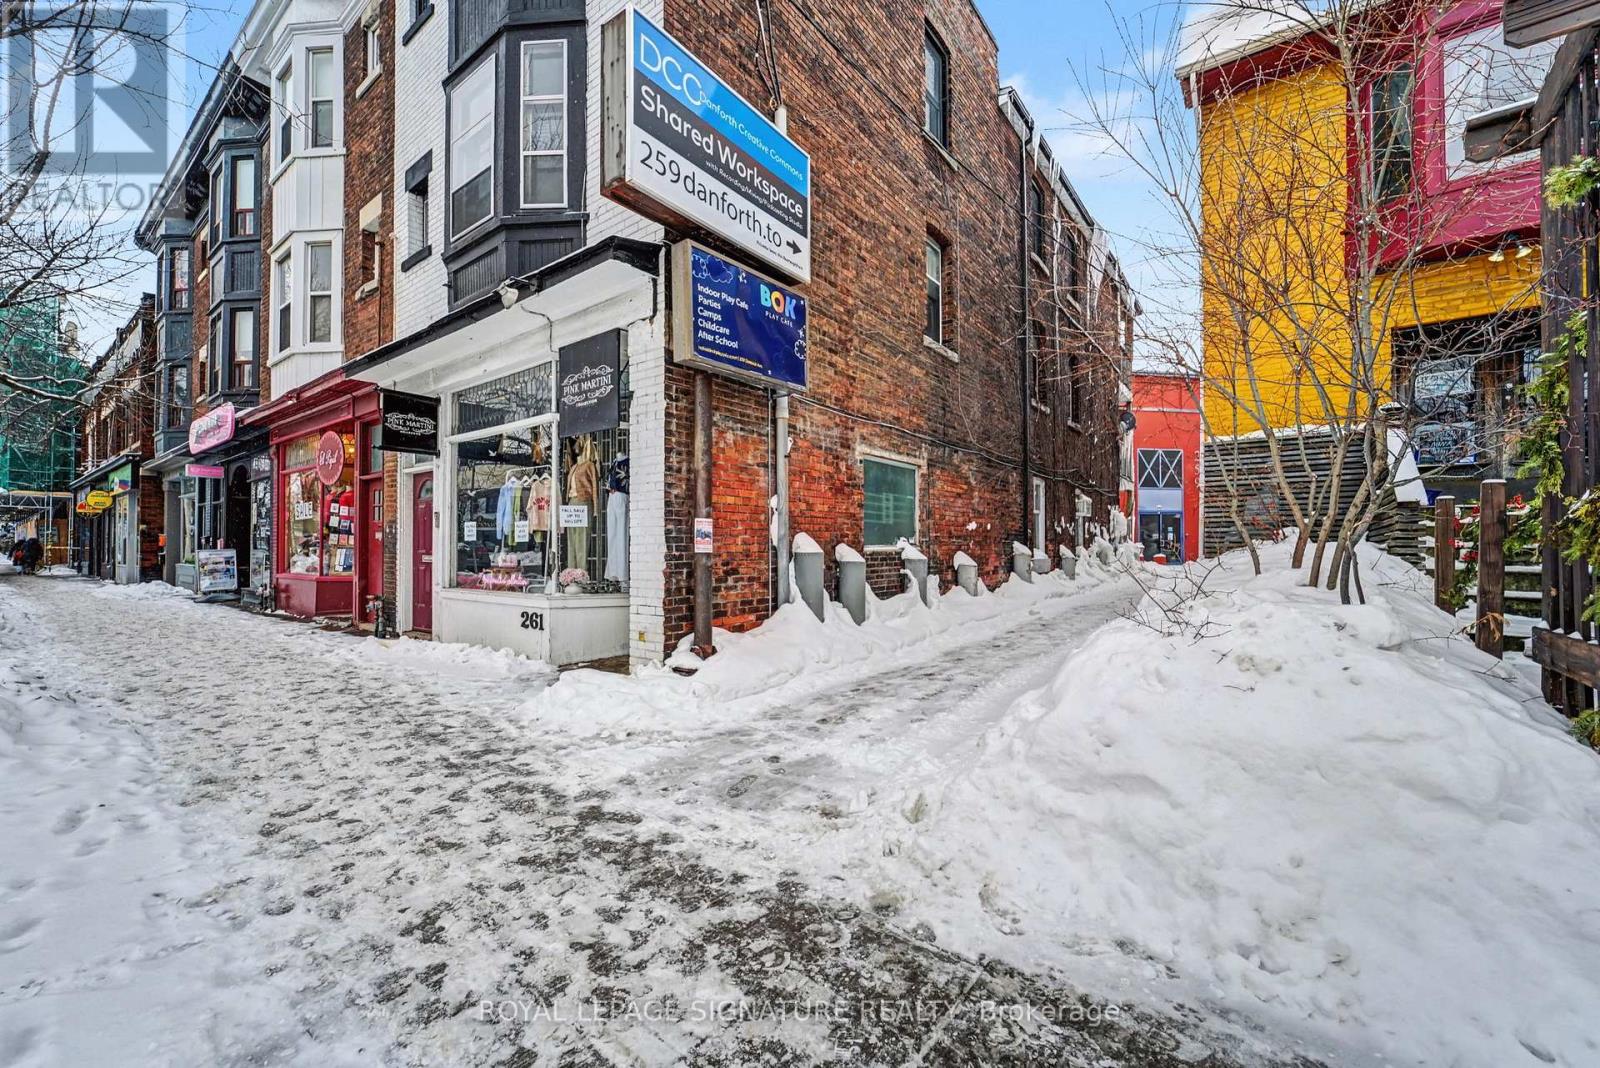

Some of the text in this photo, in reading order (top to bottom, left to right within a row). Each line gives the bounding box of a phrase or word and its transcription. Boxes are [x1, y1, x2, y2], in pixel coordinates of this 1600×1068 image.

[640, 32, 702, 106] DCC
[700, 90, 804, 181] Danforth Creative Commons
[640, 84, 804, 218] Shared Workspace
[705, 159, 719, 173] with
[639, 140, 783, 248] 259danforth.to
[697, 283, 749, 311] Indoor Play Cafe
[698, 294, 722, 310] Parties
[760, 283, 796, 320] BOK
[697, 306, 722, 322] Camps
[765, 310, 780, 321] PLAY
[697, 318, 730, 335] Childcare
[697, 329, 739, 350] After School
[563, 374, 612, 396] PINK MARTINI
[387, 417, 434, 430] PINK MARTINI
[296, 501, 313, 519] SALE
[520, 611, 545, 631] 261
